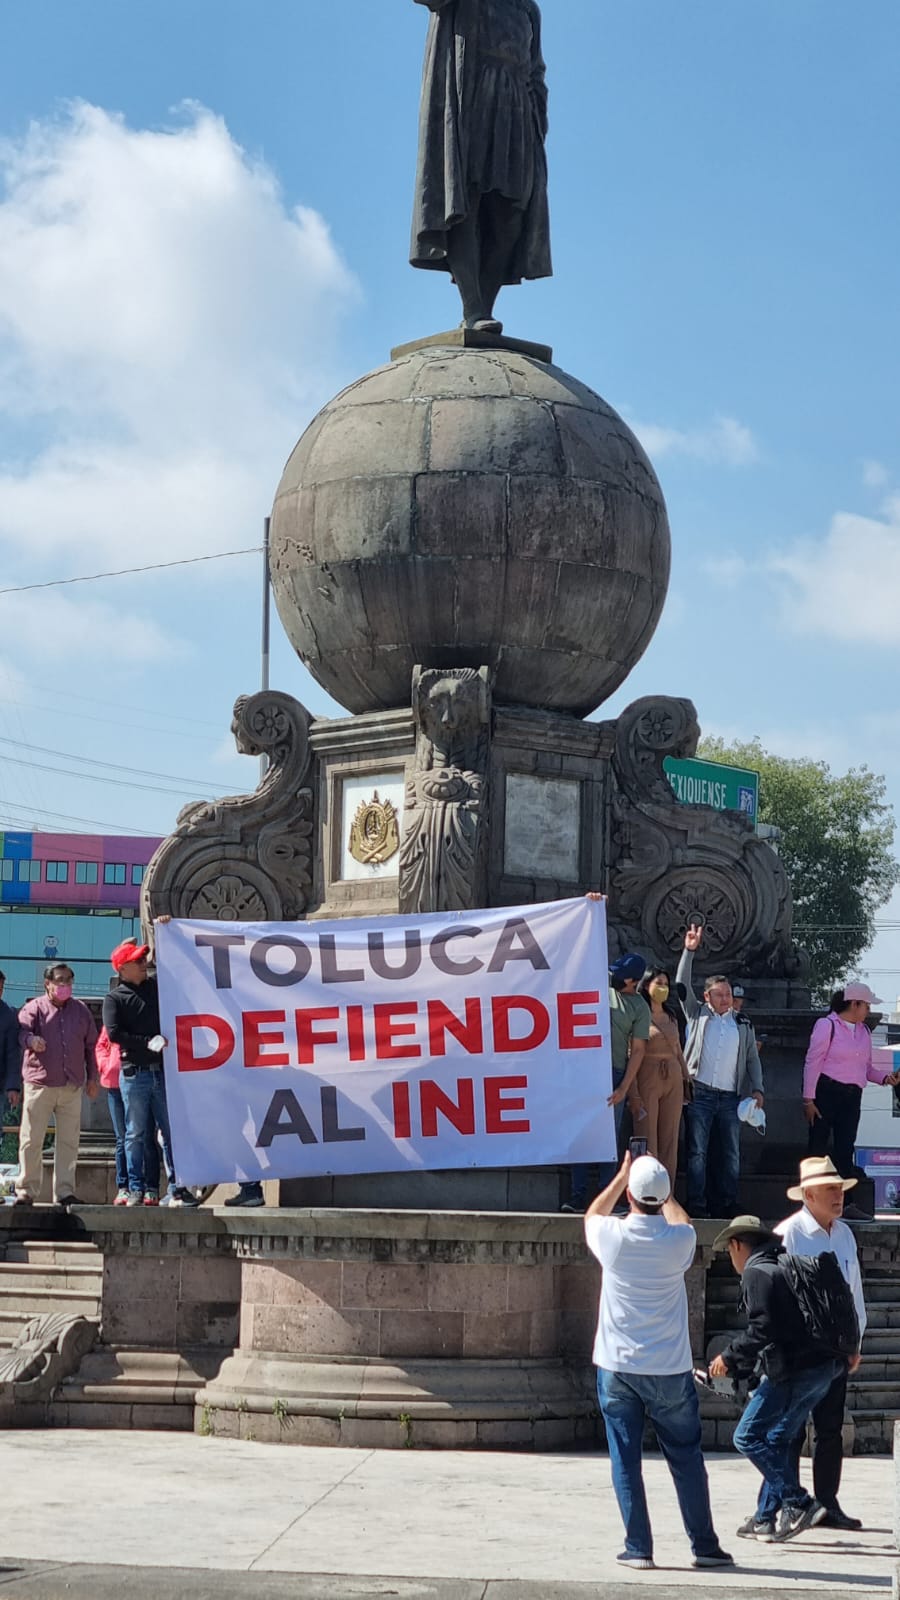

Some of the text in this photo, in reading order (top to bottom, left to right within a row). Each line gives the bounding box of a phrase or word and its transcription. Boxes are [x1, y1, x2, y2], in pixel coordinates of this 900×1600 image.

[666, 773, 727, 808] EXIQUENSE
[195, 918, 549, 989] TOLUCA
[175, 991, 602, 1072] DEFIENDE
[256, 1075, 530, 1147] AL INE
